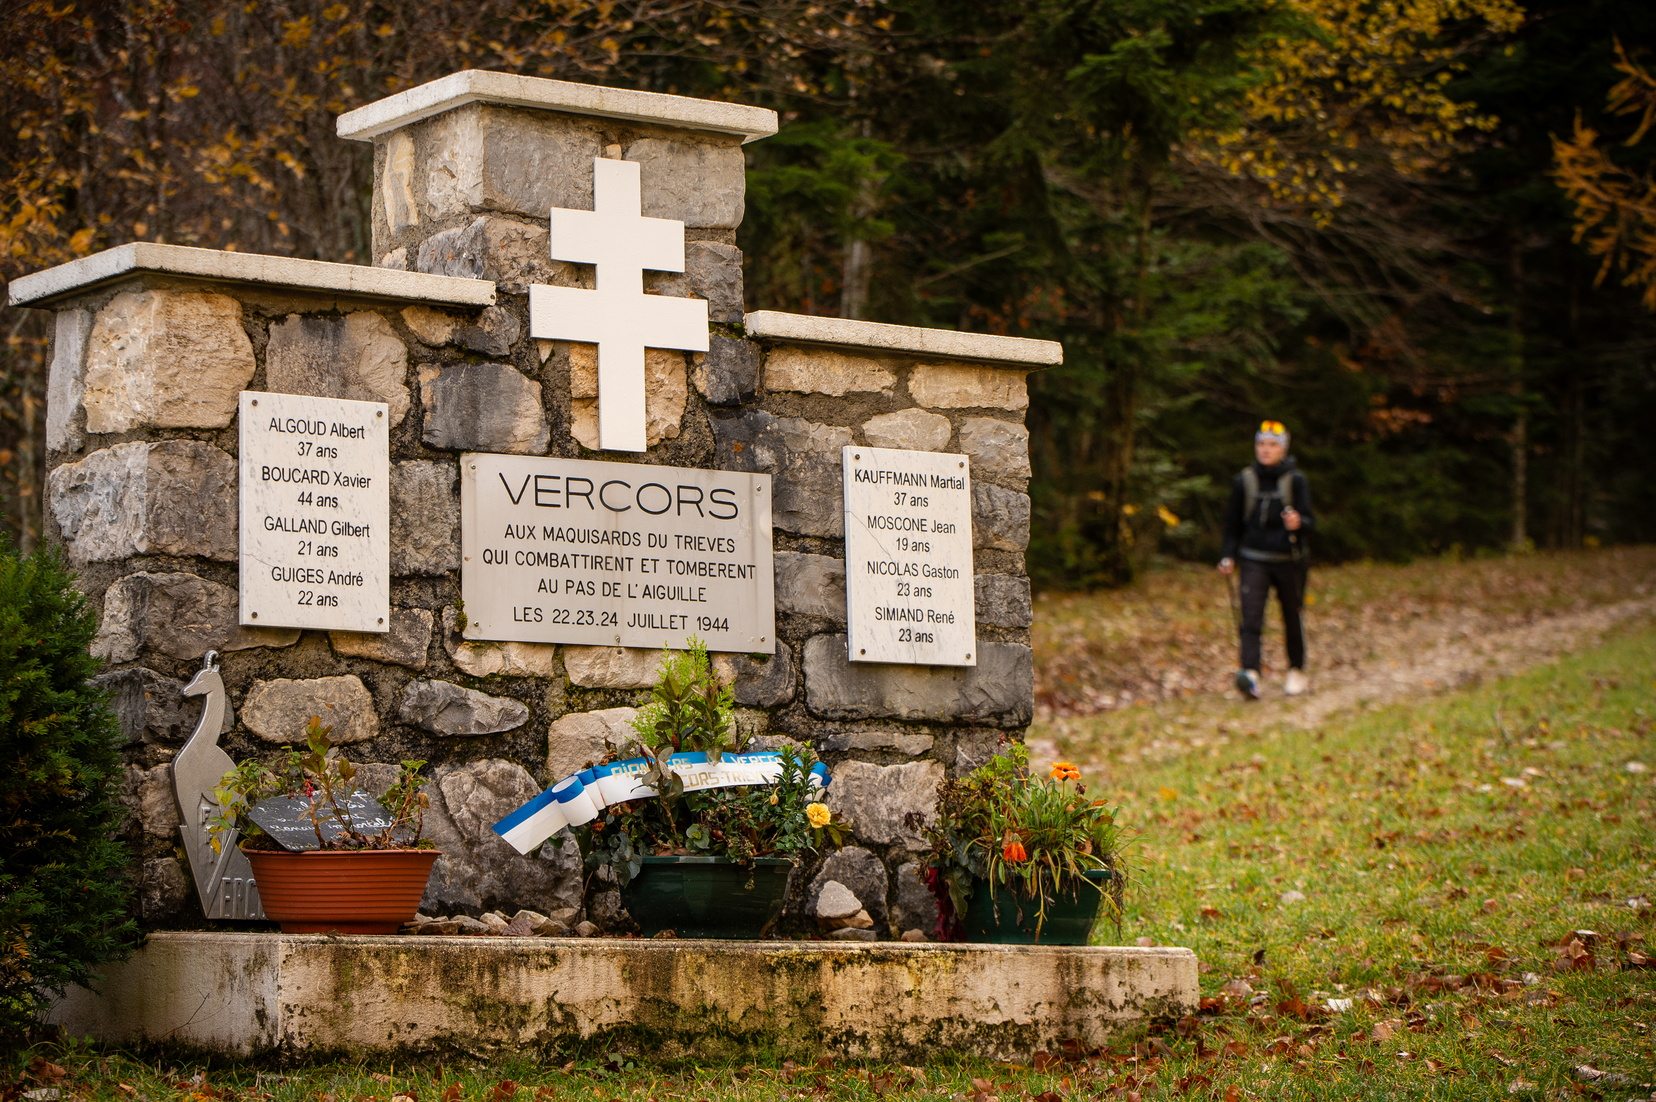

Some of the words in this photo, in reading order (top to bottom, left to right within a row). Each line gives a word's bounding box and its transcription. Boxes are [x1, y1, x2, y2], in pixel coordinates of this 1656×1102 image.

[269, 418, 326, 435] ALGOUD
[330, 423, 364, 439] Albert
[298, 442, 312, 456] 37
[316, 447, 337, 458] ans
[262, 466, 329, 485] BOUCARD
[334, 472, 371, 488] Xavier
[855, 469, 926, 487] KAUFFMANN
[931, 475, 964, 489] Martial
[298, 491, 312, 505] 44
[317, 496, 338, 508] ans
[499, 473, 738, 520] VERCORS
[894, 492, 906, 505] 37
[910, 496, 928, 507] ans
[264, 516, 327, 534] GALLAND
[332, 521, 369, 537] Gilbert
[868, 515, 927, 532] MOSCONE
[931, 520, 955, 533] Jean
[505, 524, 536, 540] AUX
[544, 526, 641, 546] MAQUISARDS
[648, 533, 667, 548] DU
[674, 535, 735, 553] TRIEVES
[897, 538, 908, 551] 19
[912, 542, 930, 552] ans
[298, 541, 311, 555] 21
[317, 546, 338, 557] ans
[483, 549, 507, 564] QUI
[515, 551, 633, 571] COMBATTIRENT
[641, 558, 659, 573] ET
[666, 560, 756, 579] TOMBERENT
[868, 561, 918, 576] NICOLAS
[922, 564, 959, 578] Gaston
[272, 567, 324, 584] GUIGES
[328, 571, 363, 586] André
[298, 591, 313, 605] 22
[317, 595, 338, 607] ans
[538, 578, 557, 593] AU
[566, 580, 595, 596] PAS
[603, 582, 621, 597] DE
[628, 584, 706, 602] L'AIGUILLE
[897, 583, 910, 596] 23
[914, 587, 932, 597] ans
[514, 607, 543, 622] LES
[553, 609, 618, 626] 22.23.24
[627, 613, 688, 629] JUILLET
[697, 617, 729, 632] 1944
[876, 607, 923, 622] SIMIAND
[928, 610, 954, 624] René
[899, 629, 911, 642] 23
[915, 632, 933, 643] ans
